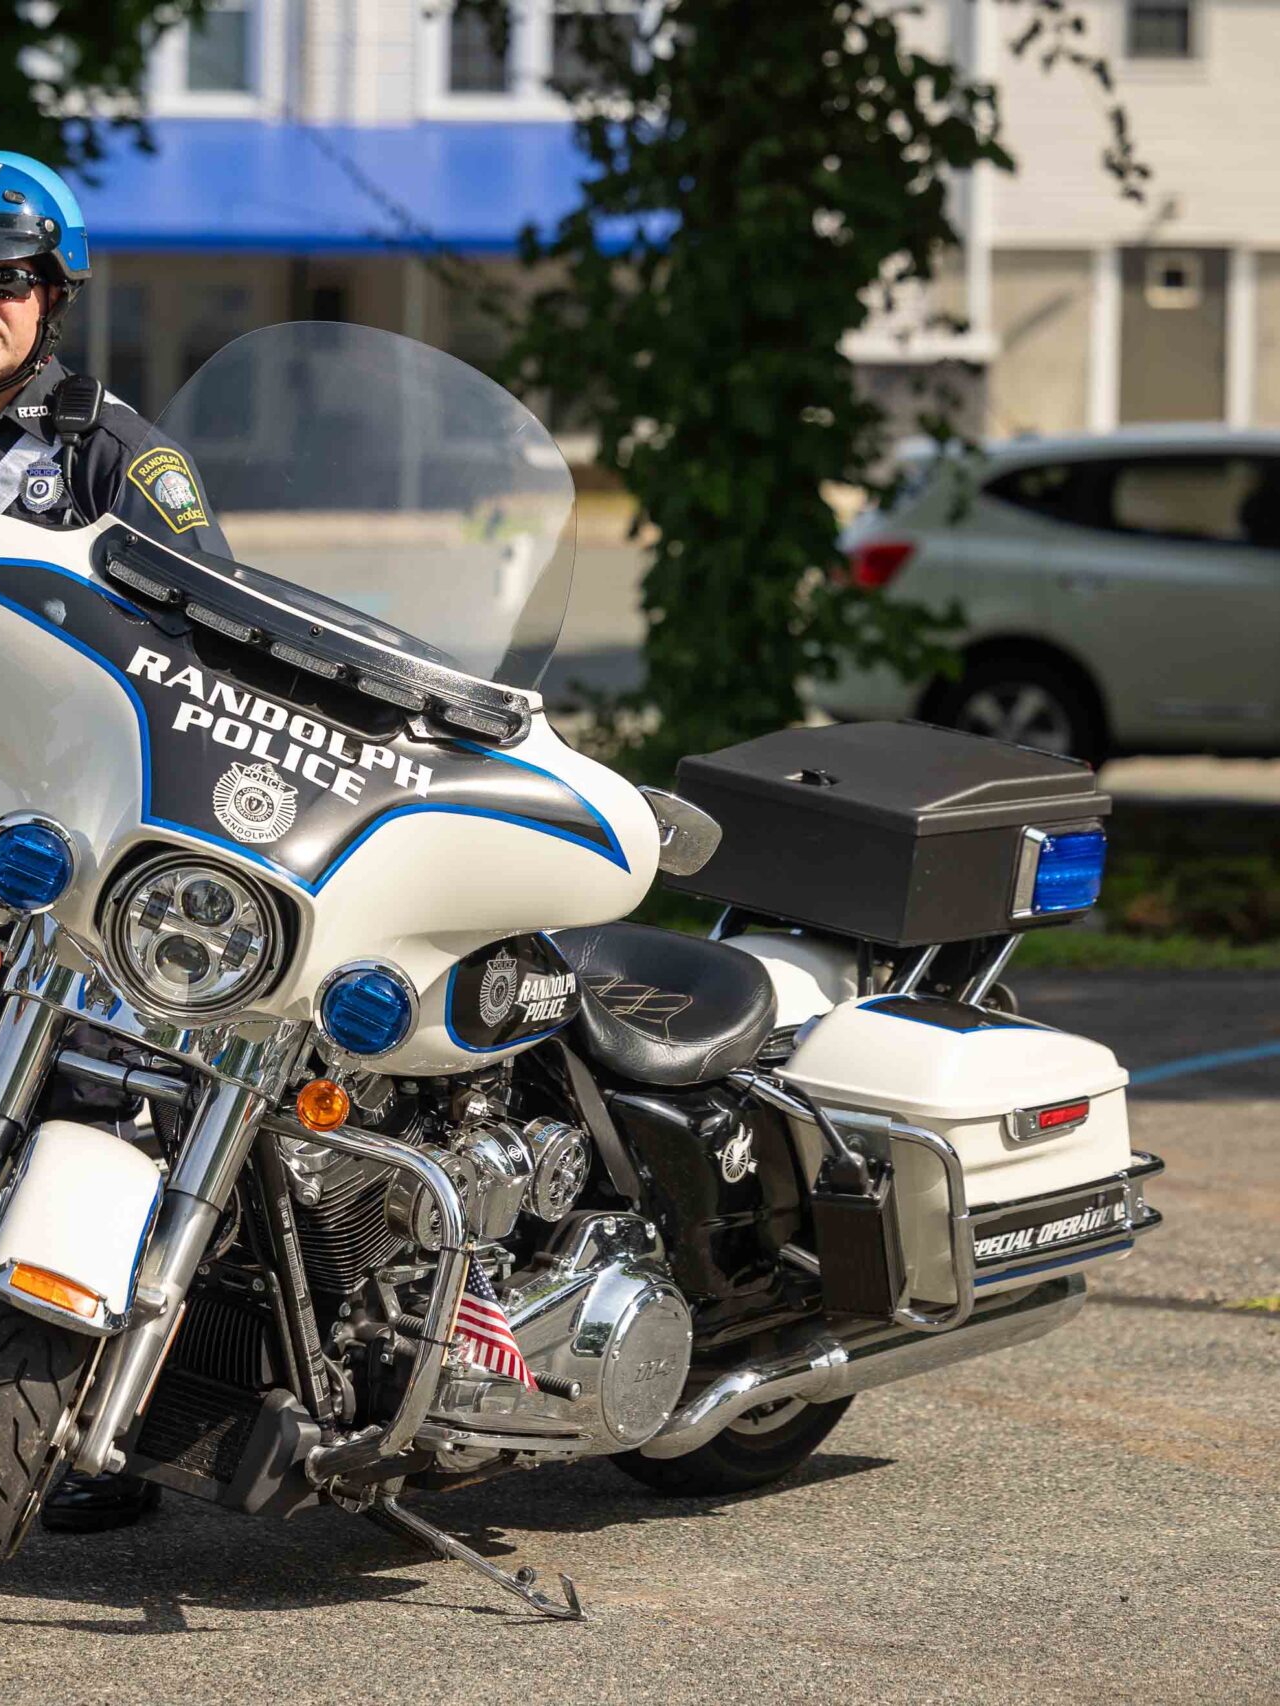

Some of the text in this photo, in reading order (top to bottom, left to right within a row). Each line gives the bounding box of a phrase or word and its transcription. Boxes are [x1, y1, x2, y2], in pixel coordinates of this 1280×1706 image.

[138, 454, 180, 477] RANDOLPH
[177, 508, 204, 525] POLICE
[126, 646, 433, 798] RANDOLPH
[172, 701, 366, 805] POLICE
[243, 769, 286, 793] POLICE
[220, 812, 273, 840] RANDOLPH
[518, 972, 576, 1002] RANDOLPH
[522, 998, 567, 1023] POLICE
